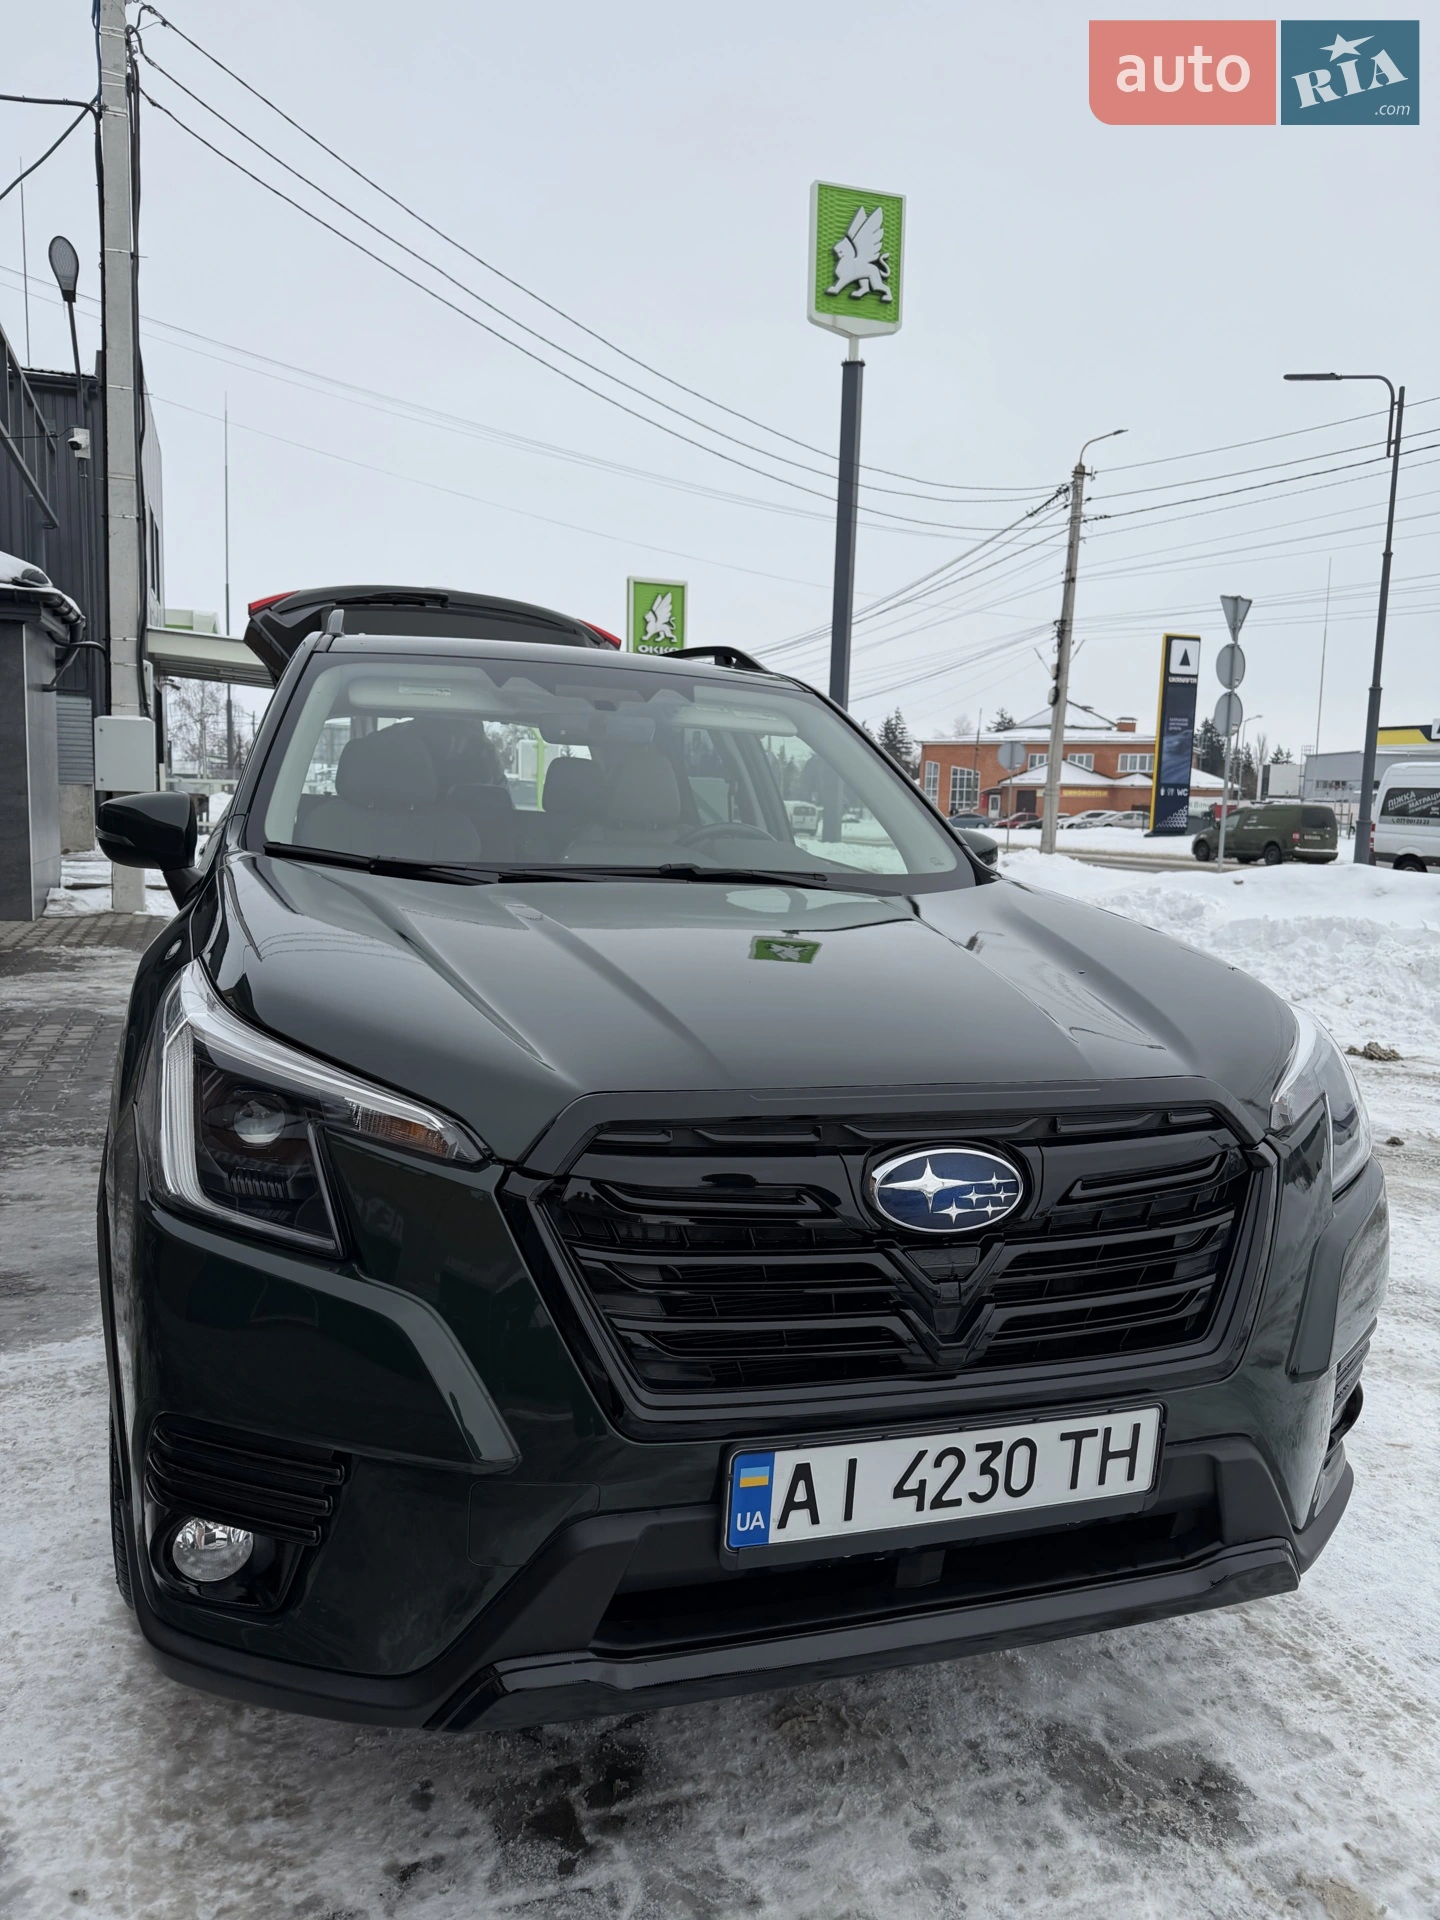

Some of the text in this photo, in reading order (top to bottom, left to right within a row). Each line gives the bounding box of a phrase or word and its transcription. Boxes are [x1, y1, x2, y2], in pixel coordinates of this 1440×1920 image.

[1177, 788, 1188, 797] WC
[777, 1422, 1141, 1530] AI 4230 TH
[736, 1511, 765, 1531] UA
